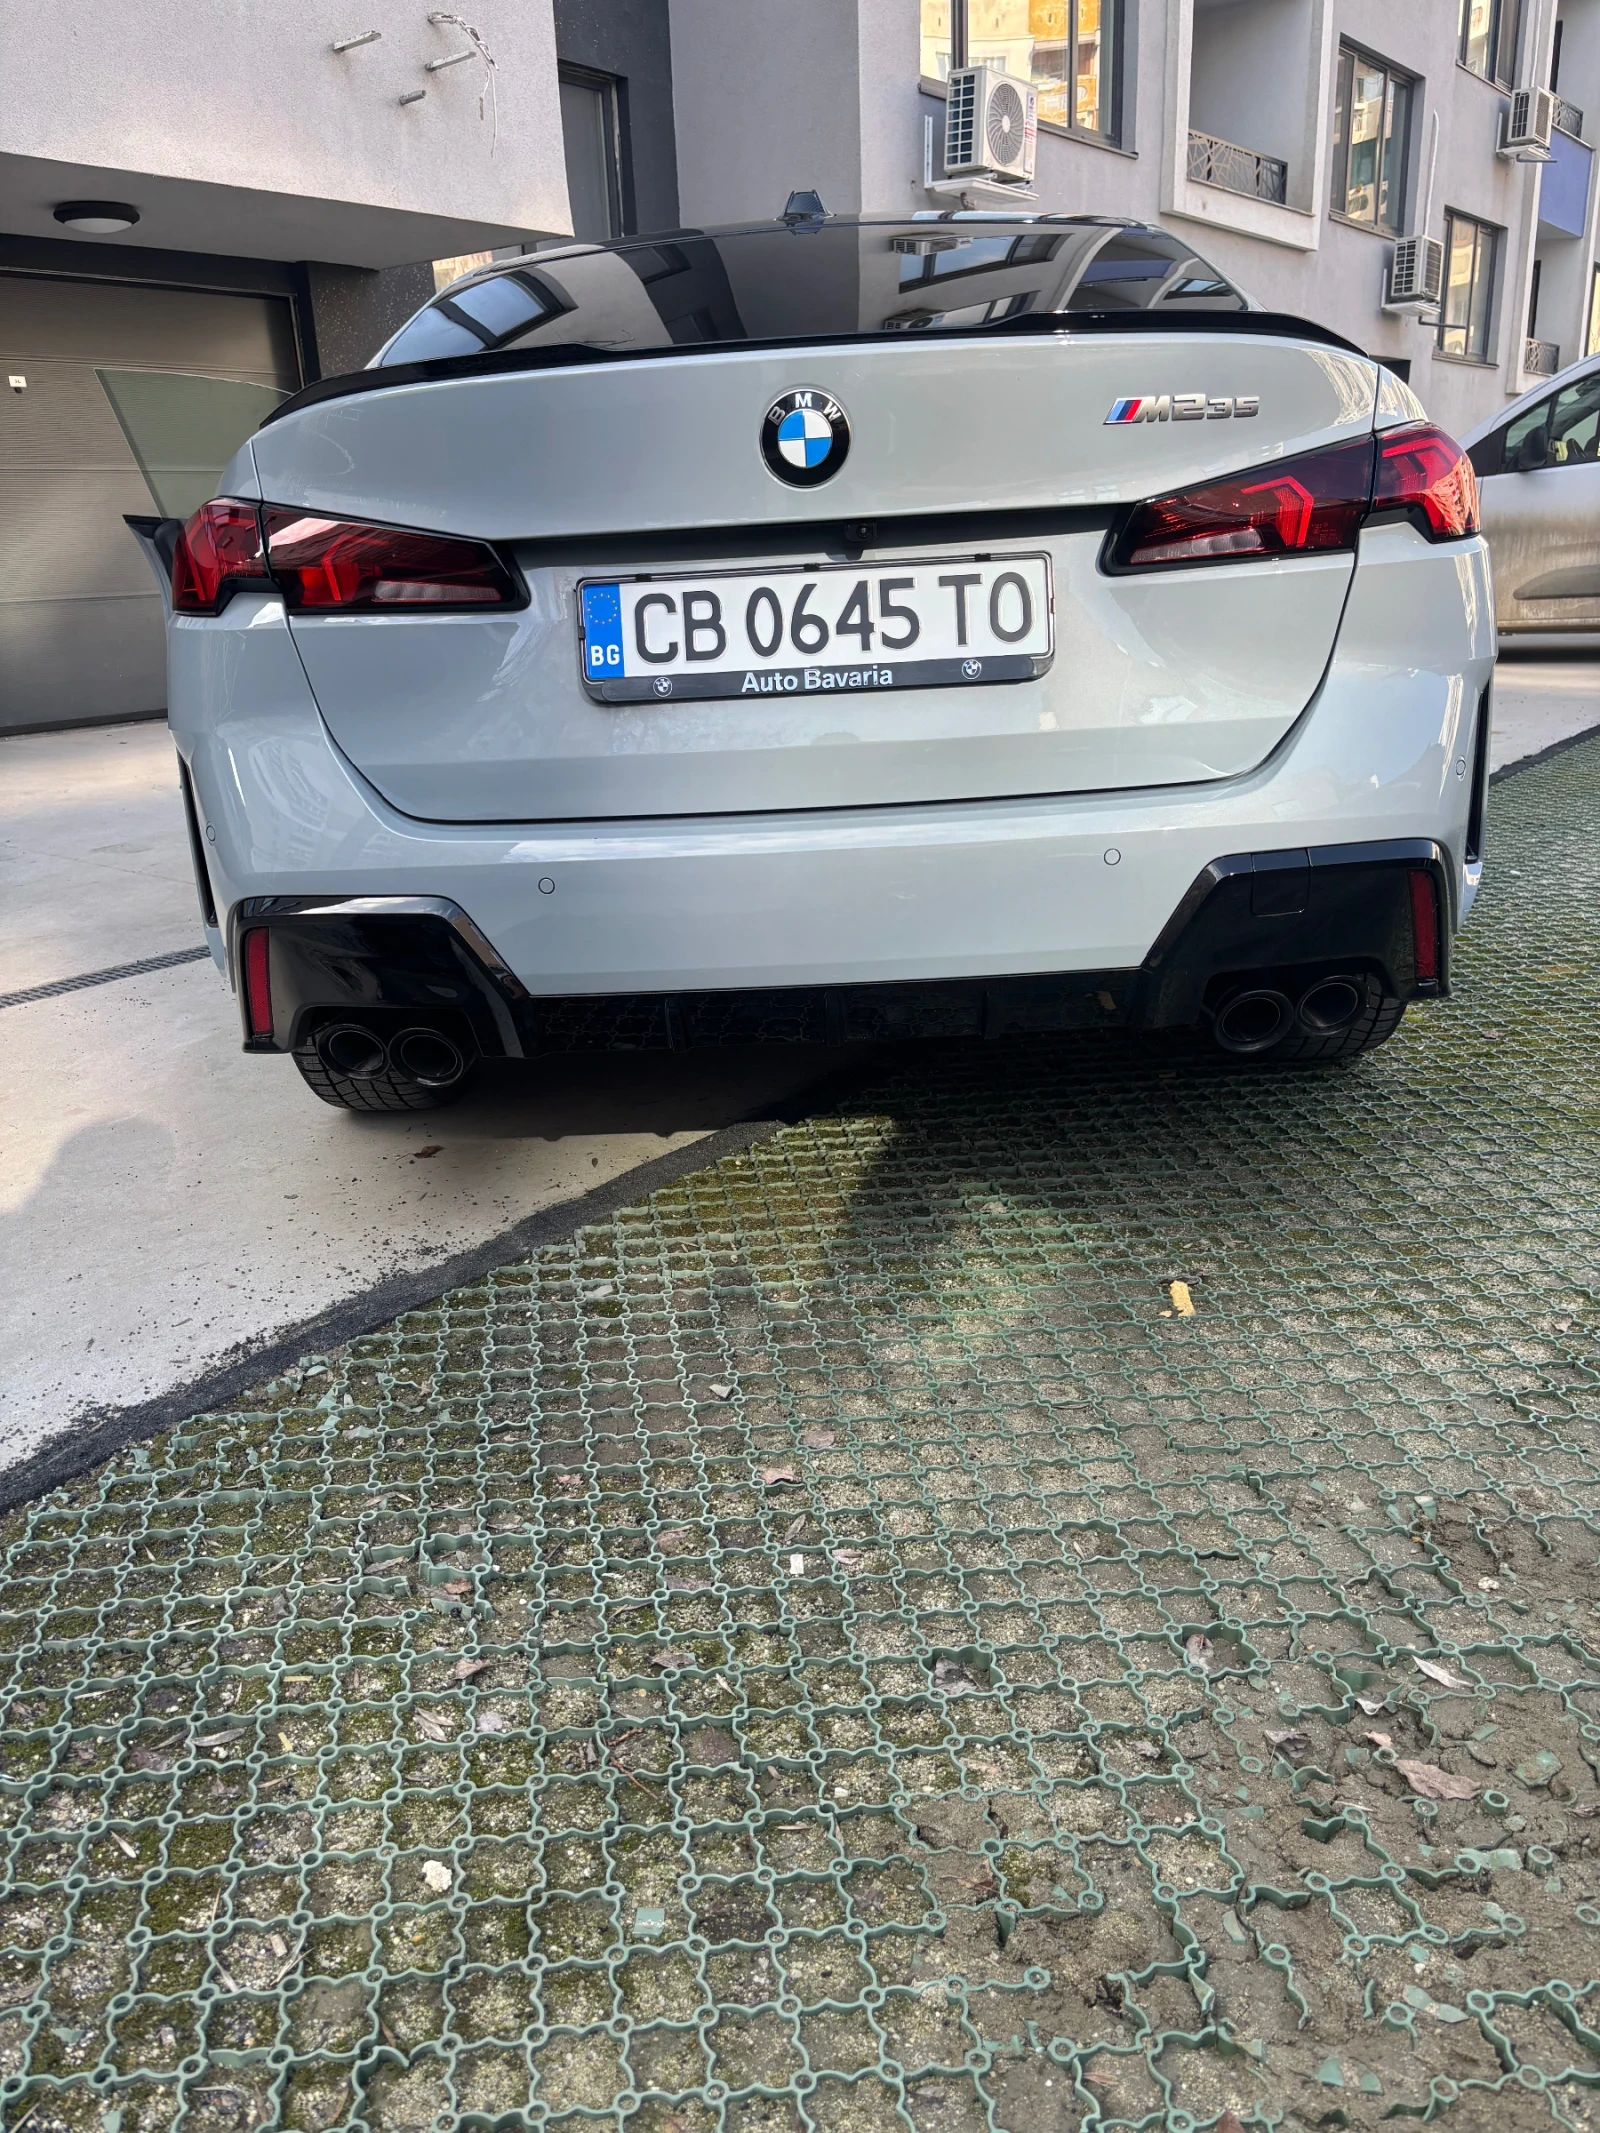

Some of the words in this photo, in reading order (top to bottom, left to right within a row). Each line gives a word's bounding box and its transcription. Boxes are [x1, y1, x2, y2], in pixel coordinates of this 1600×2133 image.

[768, 392, 842, 426] BMW
[1134, 394, 1260, 423] M235
[634, 590, 727, 664] CB
[745, 577, 922, 658] 0645
[590, 644, 620, 666] BG
[741, 672, 798, 693] Auto
[804, 665, 893, 690] Bavaria
